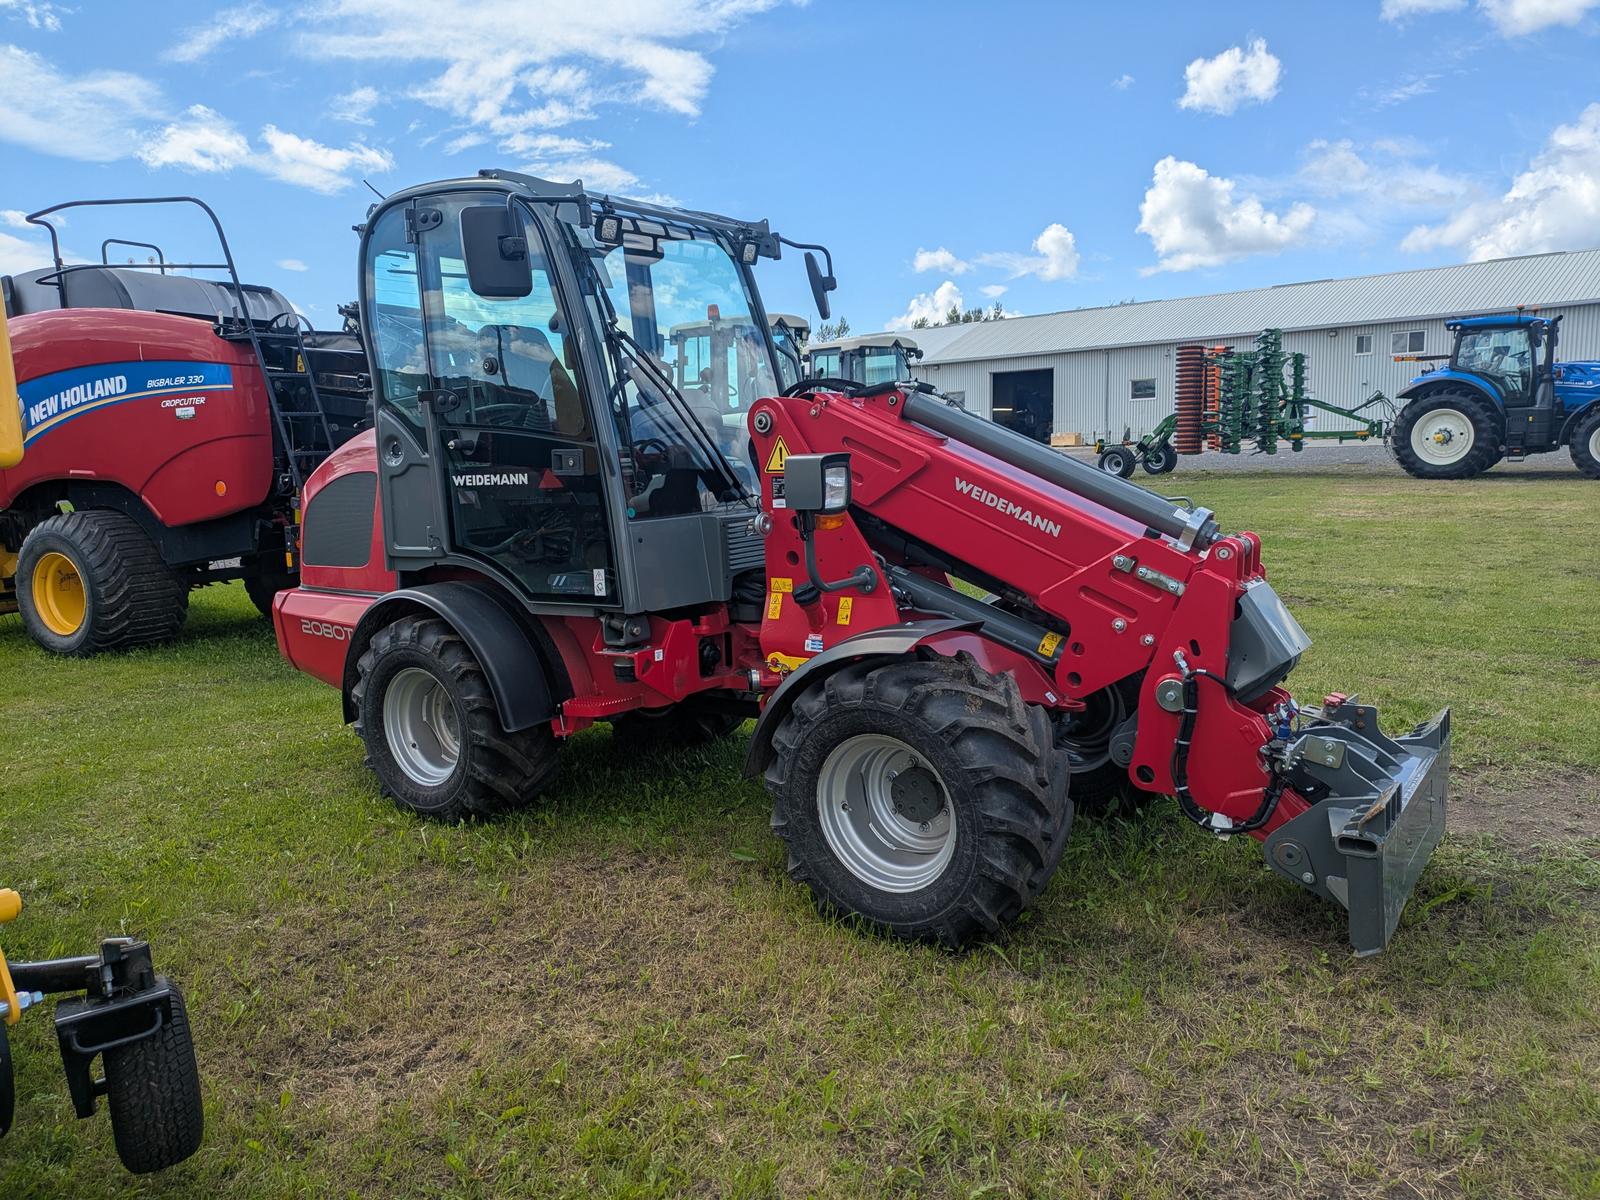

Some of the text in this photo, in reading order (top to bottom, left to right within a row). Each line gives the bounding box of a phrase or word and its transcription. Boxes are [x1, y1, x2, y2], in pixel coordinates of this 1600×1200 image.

[146, 375, 205, 389] BIGBALER 330
[29, 375, 128, 426] NEW HOLLAND
[160, 396, 206, 408] CROPCUTTER
[452, 473, 529, 487] WEIDEMANN
[954, 476, 1062, 538] WEIDEMANN
[300, 619, 354, 641] 2080T
